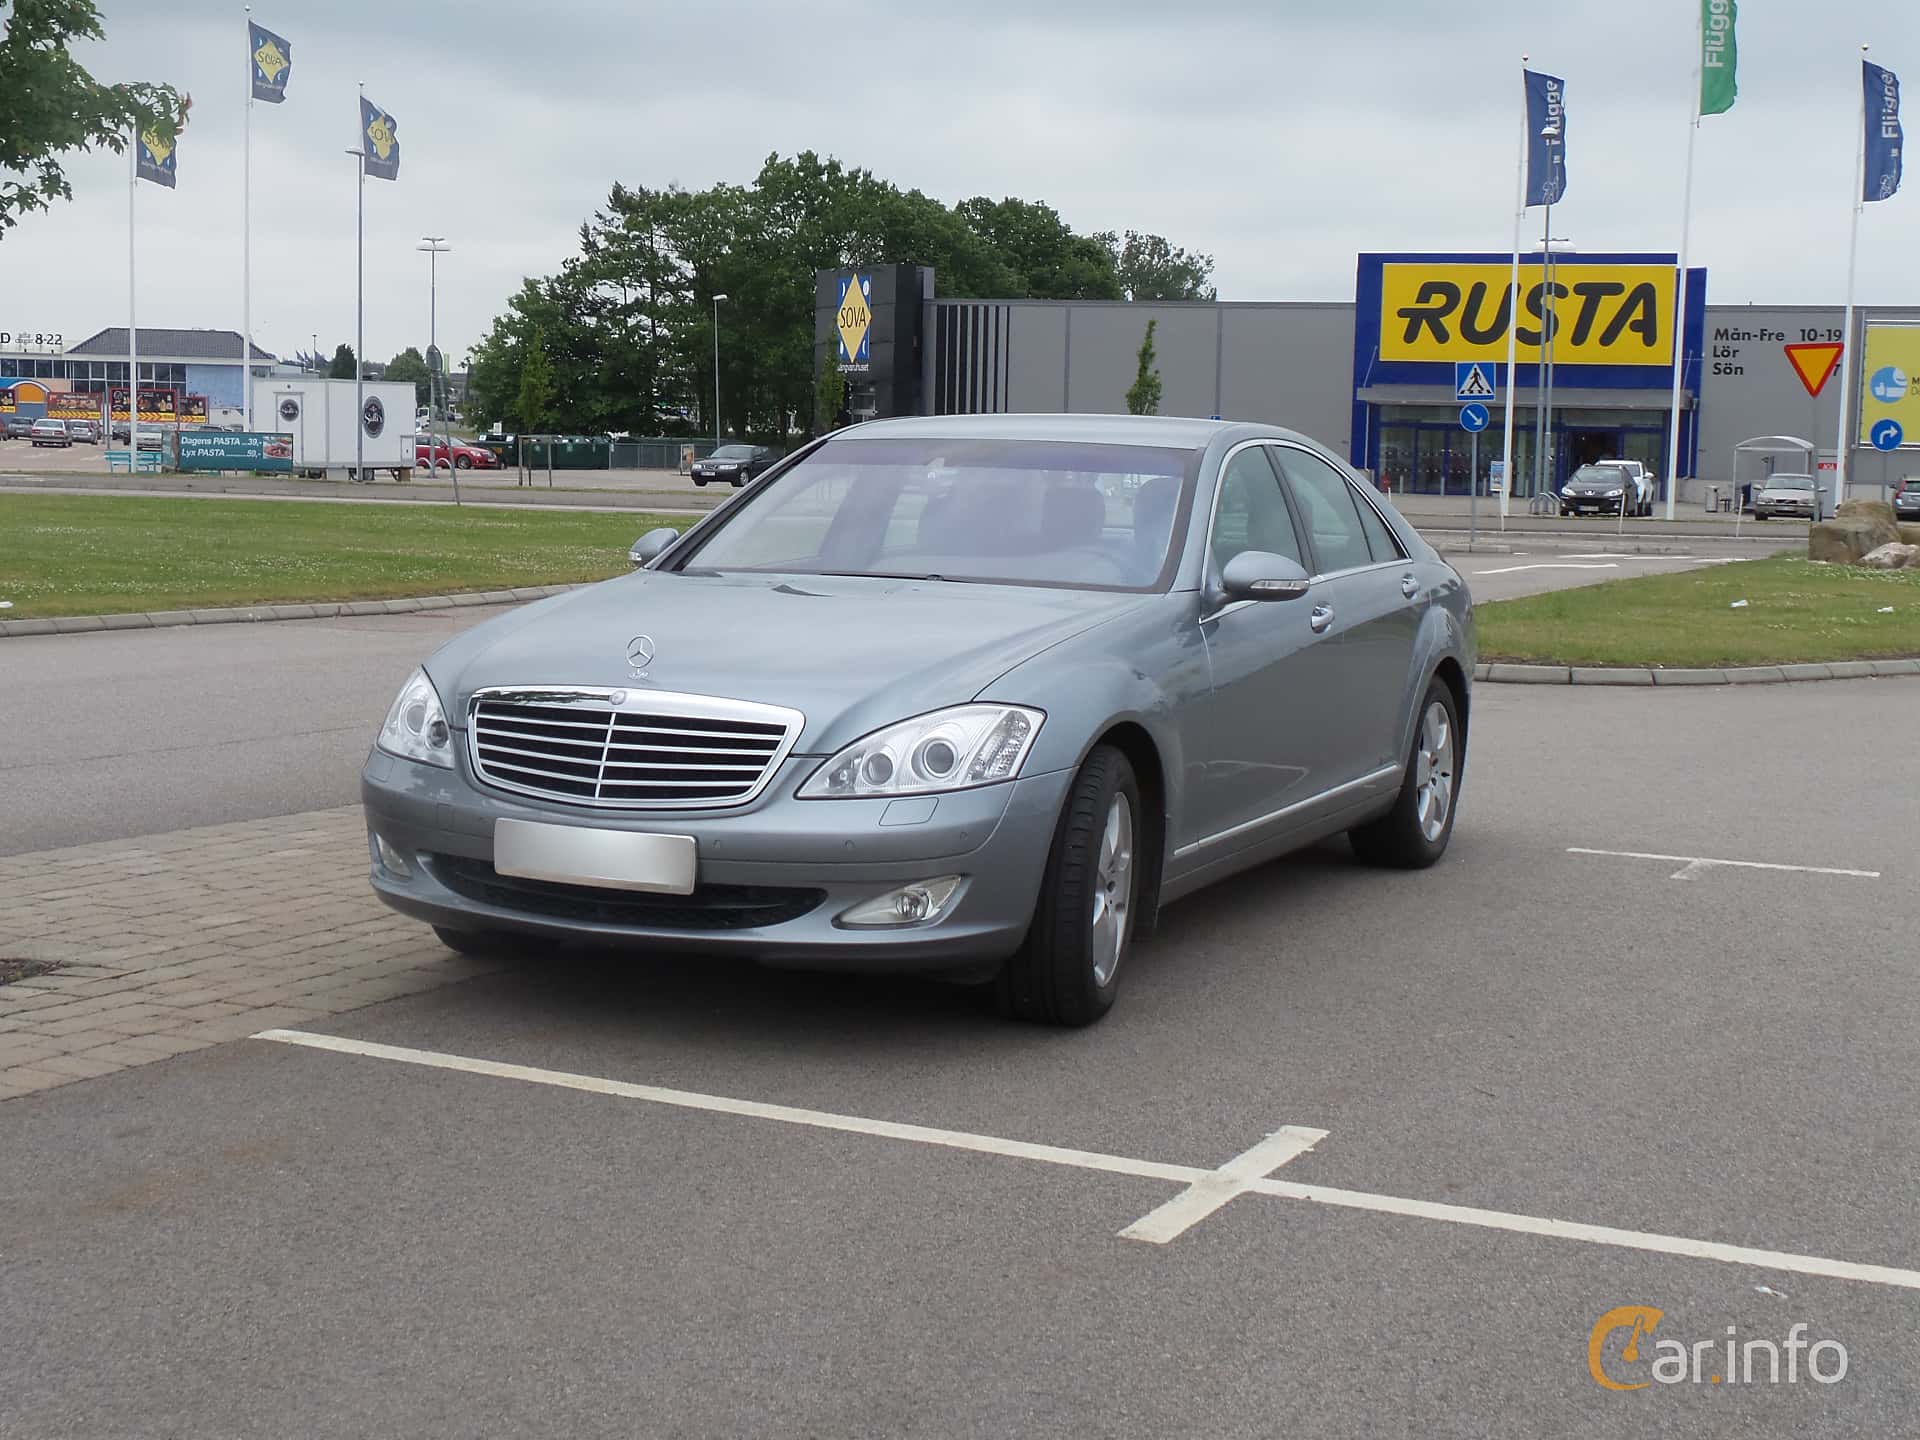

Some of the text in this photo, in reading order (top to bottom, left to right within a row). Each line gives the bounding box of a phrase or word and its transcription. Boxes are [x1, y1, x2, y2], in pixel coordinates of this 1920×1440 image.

[839, 307, 867, 328] SOVA
[1396, 281, 1658, 347] RUSTA
[35, 333, 63, 345] 8-22
[1800, 329, 1842, 342] 10-19
[1713, 345, 1739, 359] Lör
[1713, 362, 1744, 376] Sön
[181, 437, 212, 446] Dagens
[213, 437, 241, 446] PASTA
[181, 449, 196, 458] Lyx
[197, 449, 225, 457] PASTA
